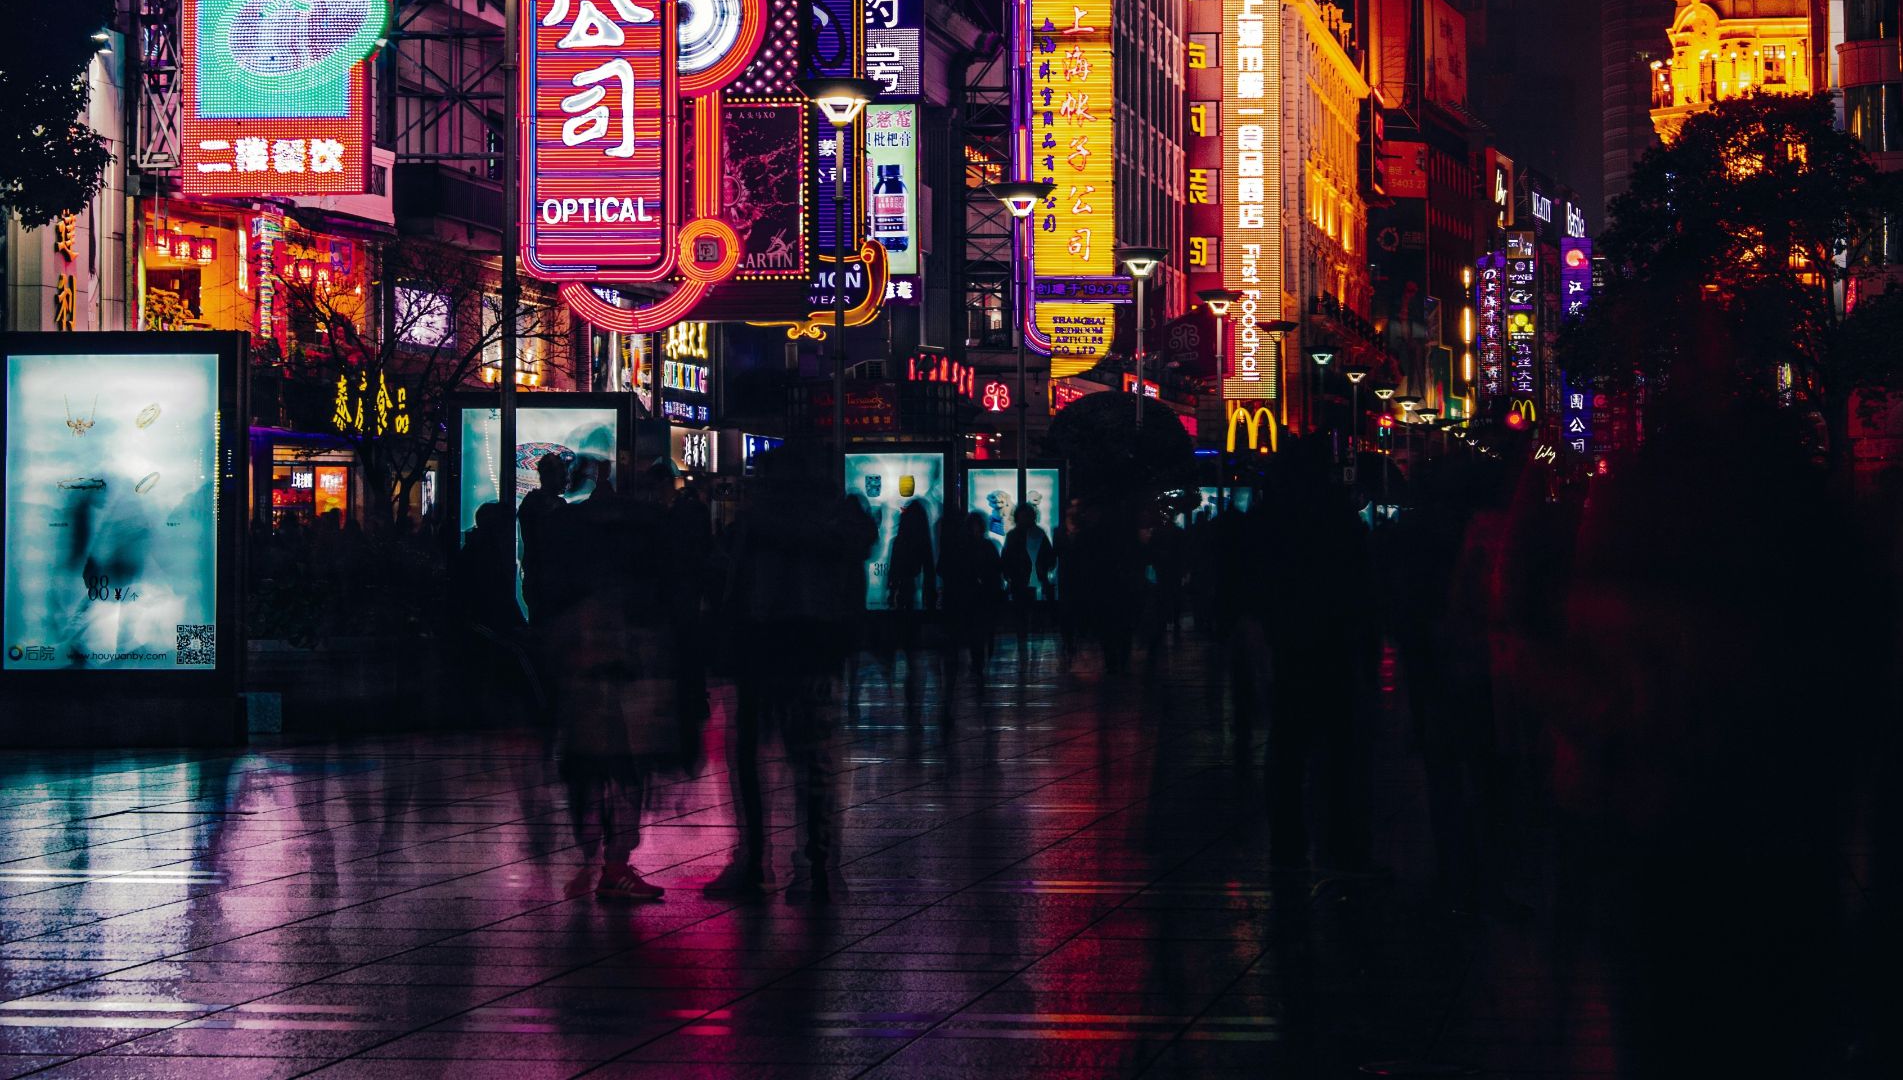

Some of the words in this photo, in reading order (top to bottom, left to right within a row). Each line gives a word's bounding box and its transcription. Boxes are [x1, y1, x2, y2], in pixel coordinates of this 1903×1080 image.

[543, 197, 653, 225] OPTICAL
[738, 252, 793, 268] ARTIN
[1242, 290, 1261, 381] Foodhall
[664, 360, 684, 390] SILK
[685, 364, 709, 394] KING
[88, 575, 110, 602] 88
[25, 646, 55, 662] 后院
